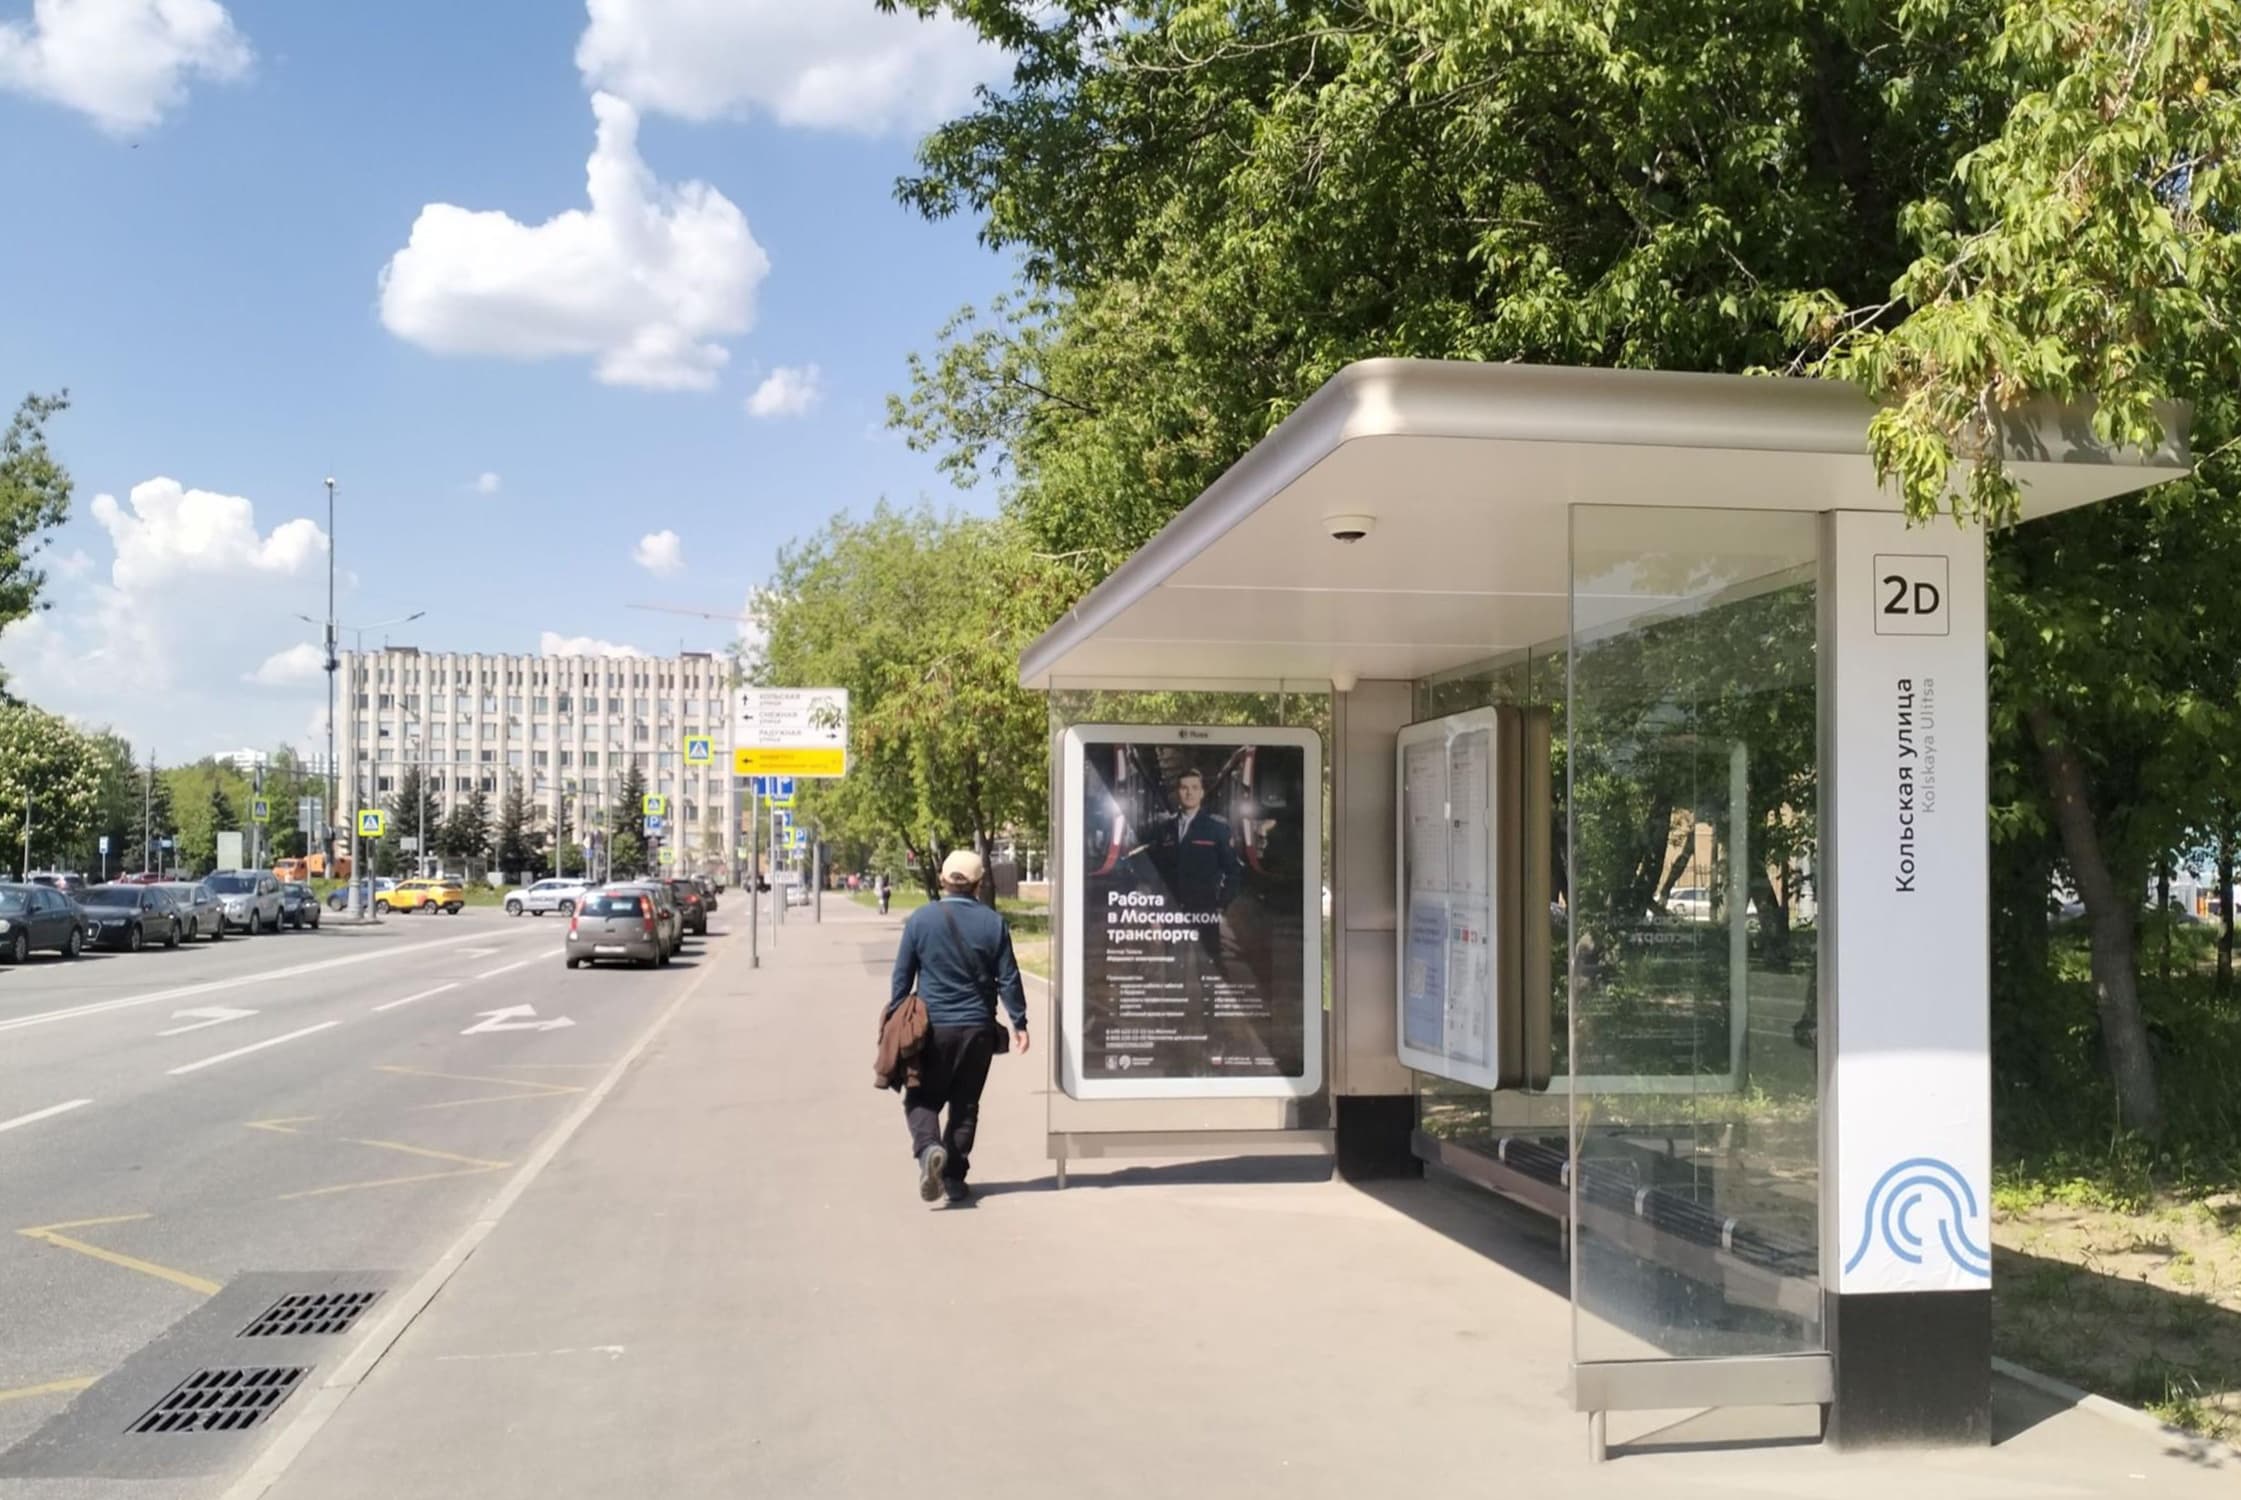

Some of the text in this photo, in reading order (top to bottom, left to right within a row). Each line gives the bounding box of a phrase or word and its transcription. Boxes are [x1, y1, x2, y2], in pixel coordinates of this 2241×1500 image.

[1882, 575, 1940, 615] 2D
[1920, 677, 1939, 814] Kolskaya Ulitsa
[1895, 677, 1917, 893] Кольская улица
[1107, 891, 1165, 907] Работа
[1107, 908, 1223, 924] в Московском
[1106, 928, 1200, 945] транспорте
